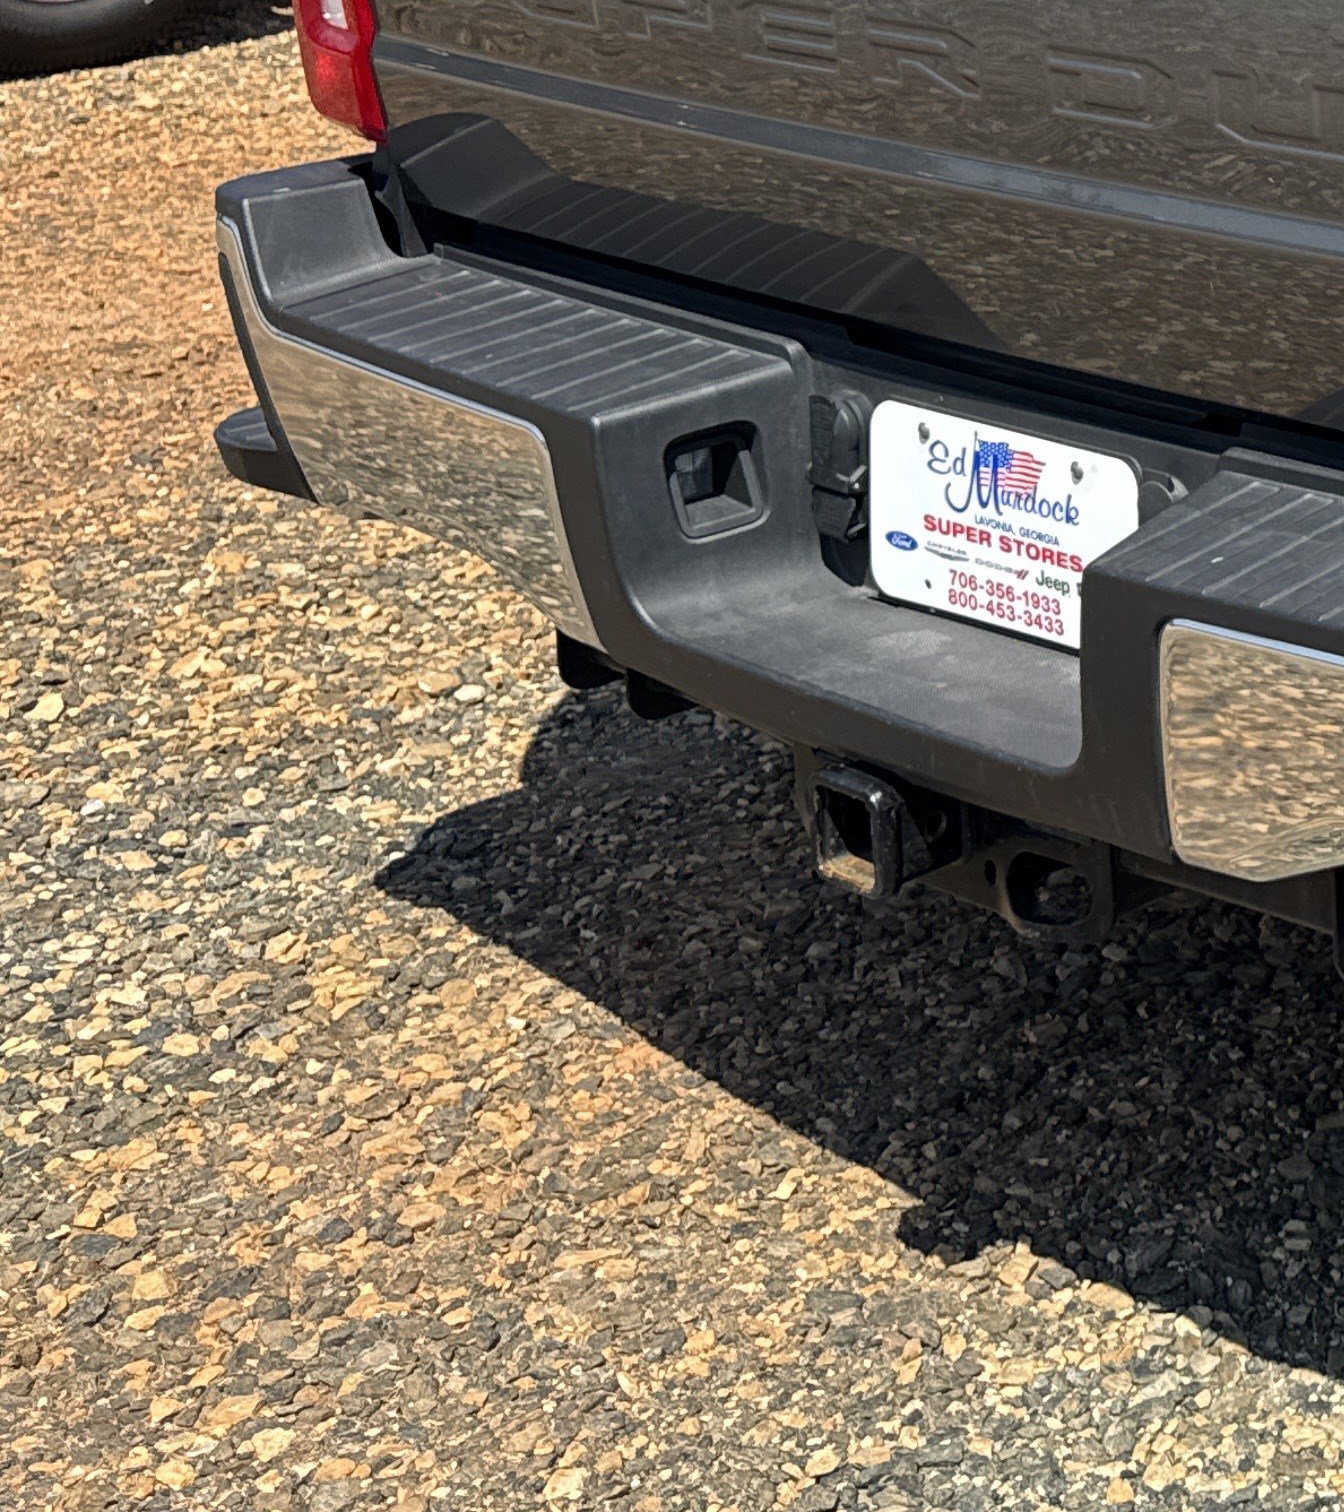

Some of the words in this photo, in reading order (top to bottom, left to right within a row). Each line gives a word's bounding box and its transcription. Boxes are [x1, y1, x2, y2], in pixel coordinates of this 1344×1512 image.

[927, 439, 968, 477] Ed
[944, 448, 1080, 526] Murdock
[923, 513, 993, 548] SUPER
[998, 534, 1083, 573] STORES
[1018, 526, 1060, 547] GEORGIA
[949, 568, 1062, 616] 706-356-1933
[1035, 569, 1071, 597] Jeep
[947, 588, 1065, 637] 800-453-3433
